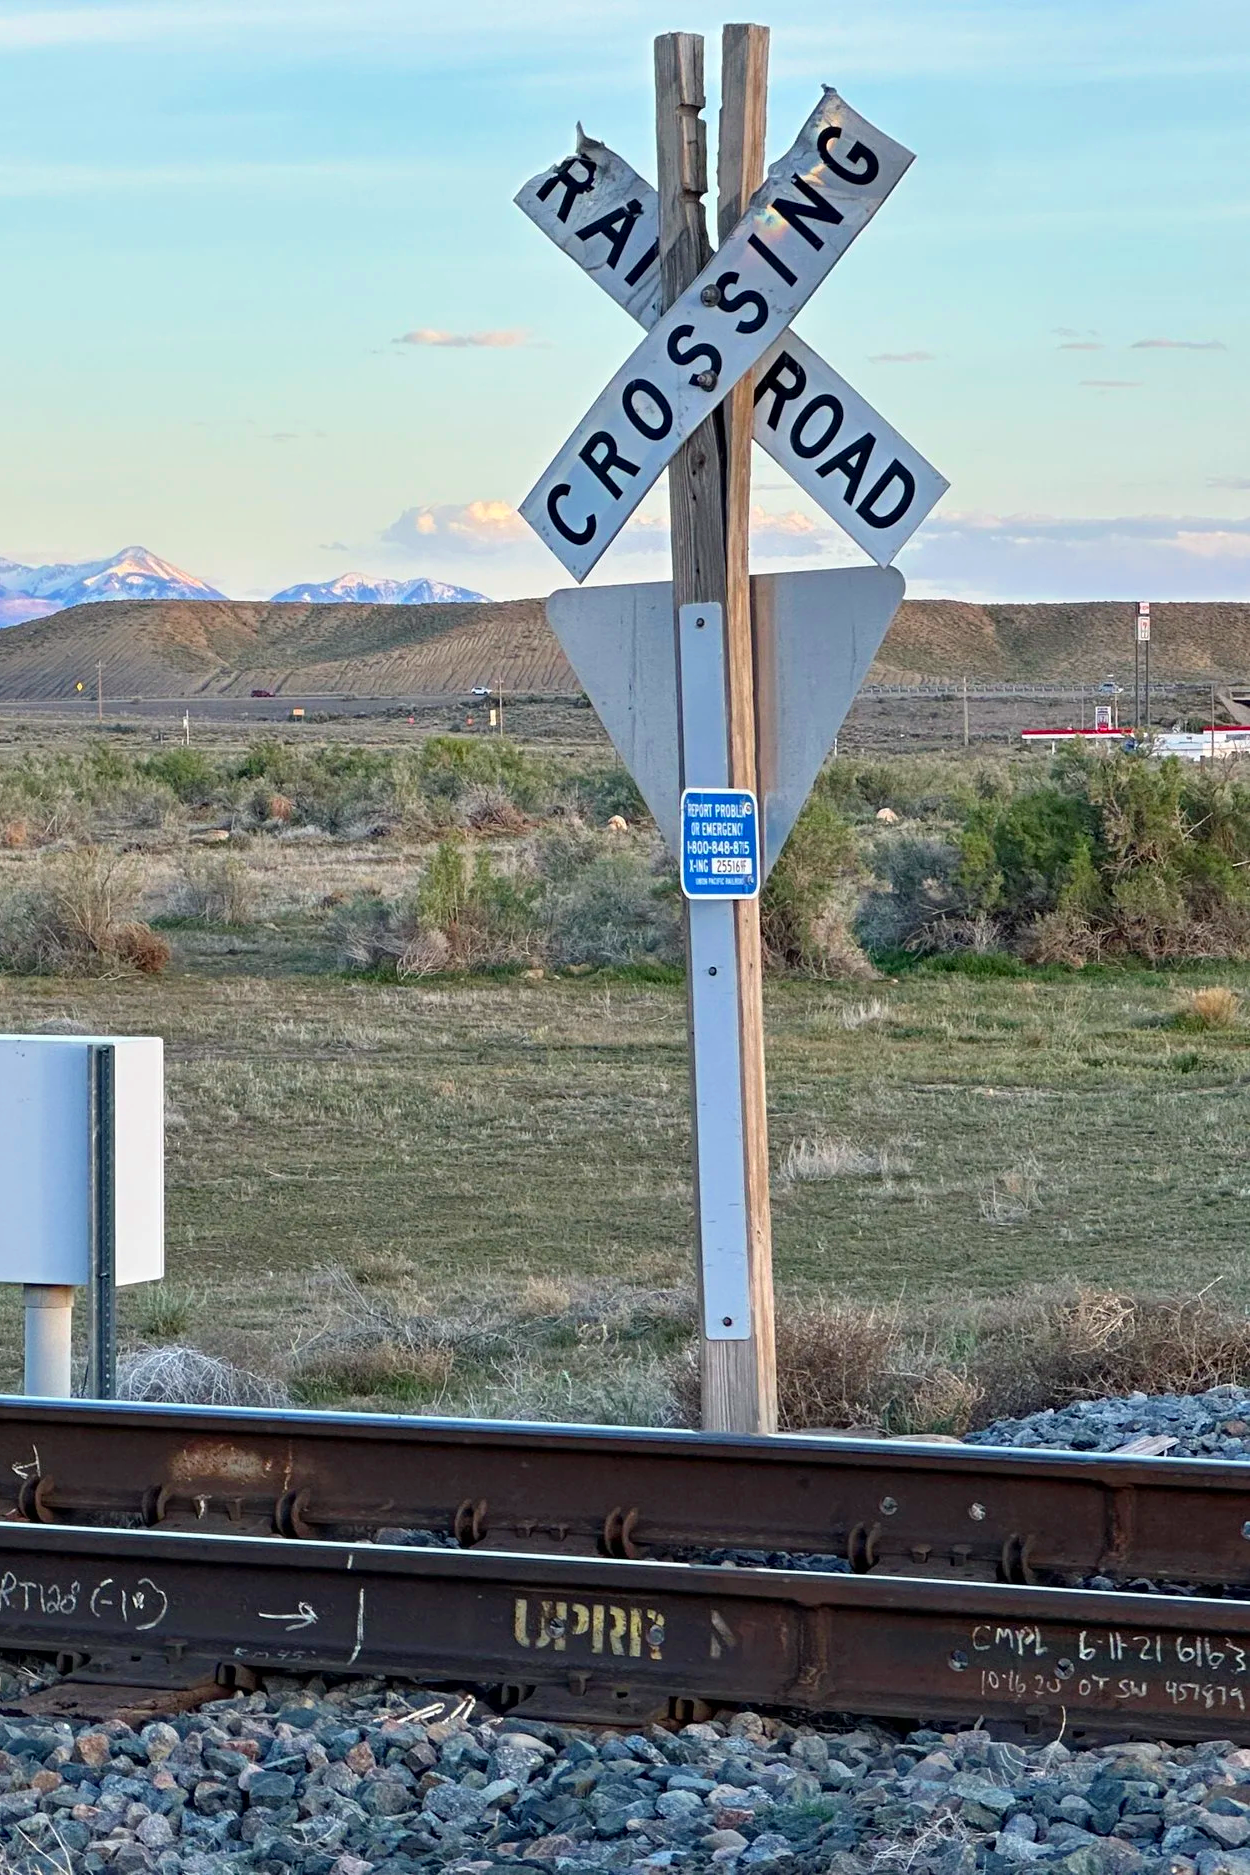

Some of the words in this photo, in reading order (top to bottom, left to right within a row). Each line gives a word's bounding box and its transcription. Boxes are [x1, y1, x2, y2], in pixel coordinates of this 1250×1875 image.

[537, 153, 660, 287] RAI
[753, 351, 916, 530] ROAD
[546, 125, 880, 546] CROSSING
[687, 803, 713, 818] REPORT
[690, 822, 700, 836] OR
[701, 822, 744, 837] EMERGENCY
[689, 858, 709, 873] X-ING
